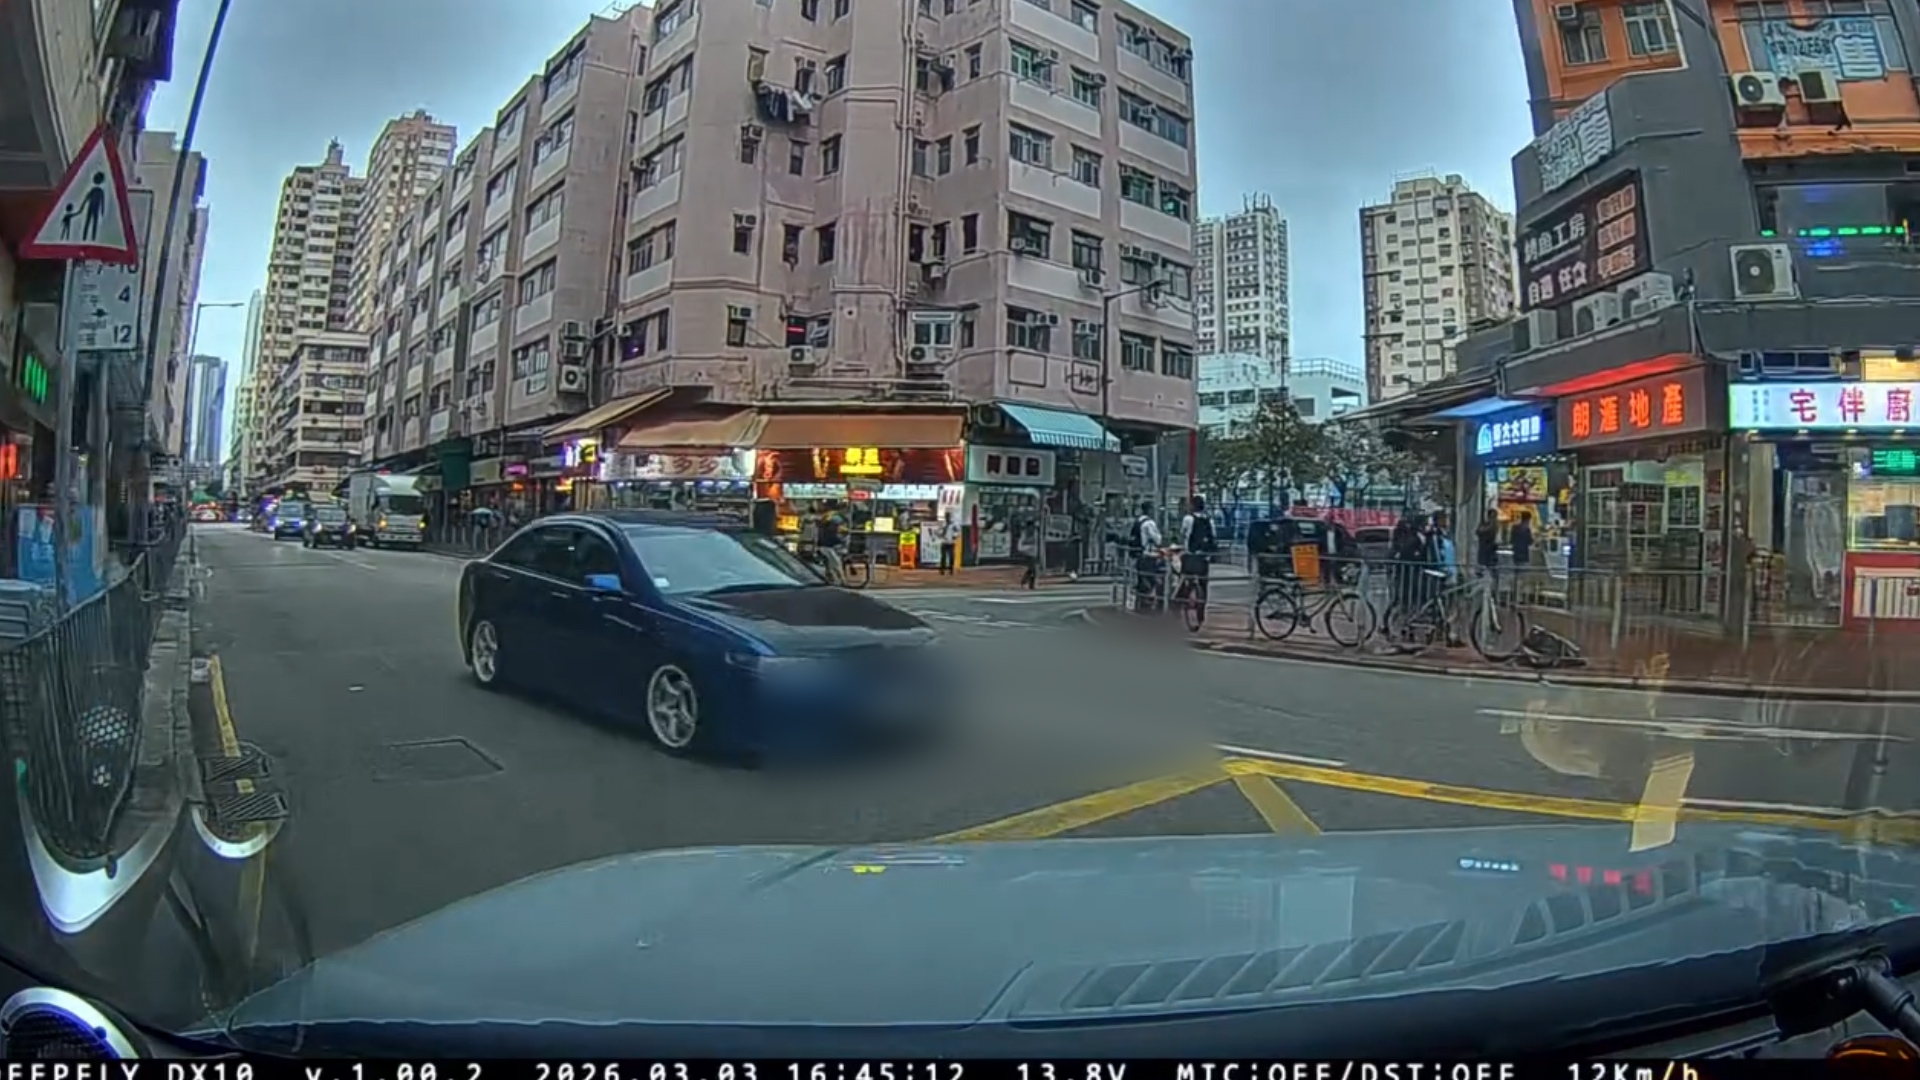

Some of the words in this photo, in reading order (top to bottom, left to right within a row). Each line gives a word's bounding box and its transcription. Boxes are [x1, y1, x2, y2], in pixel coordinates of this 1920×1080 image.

[118, 284, 132, 303] 4
[113, 324, 132, 344] 12
[1789, 386, 1912, 423] 宅伴廚
